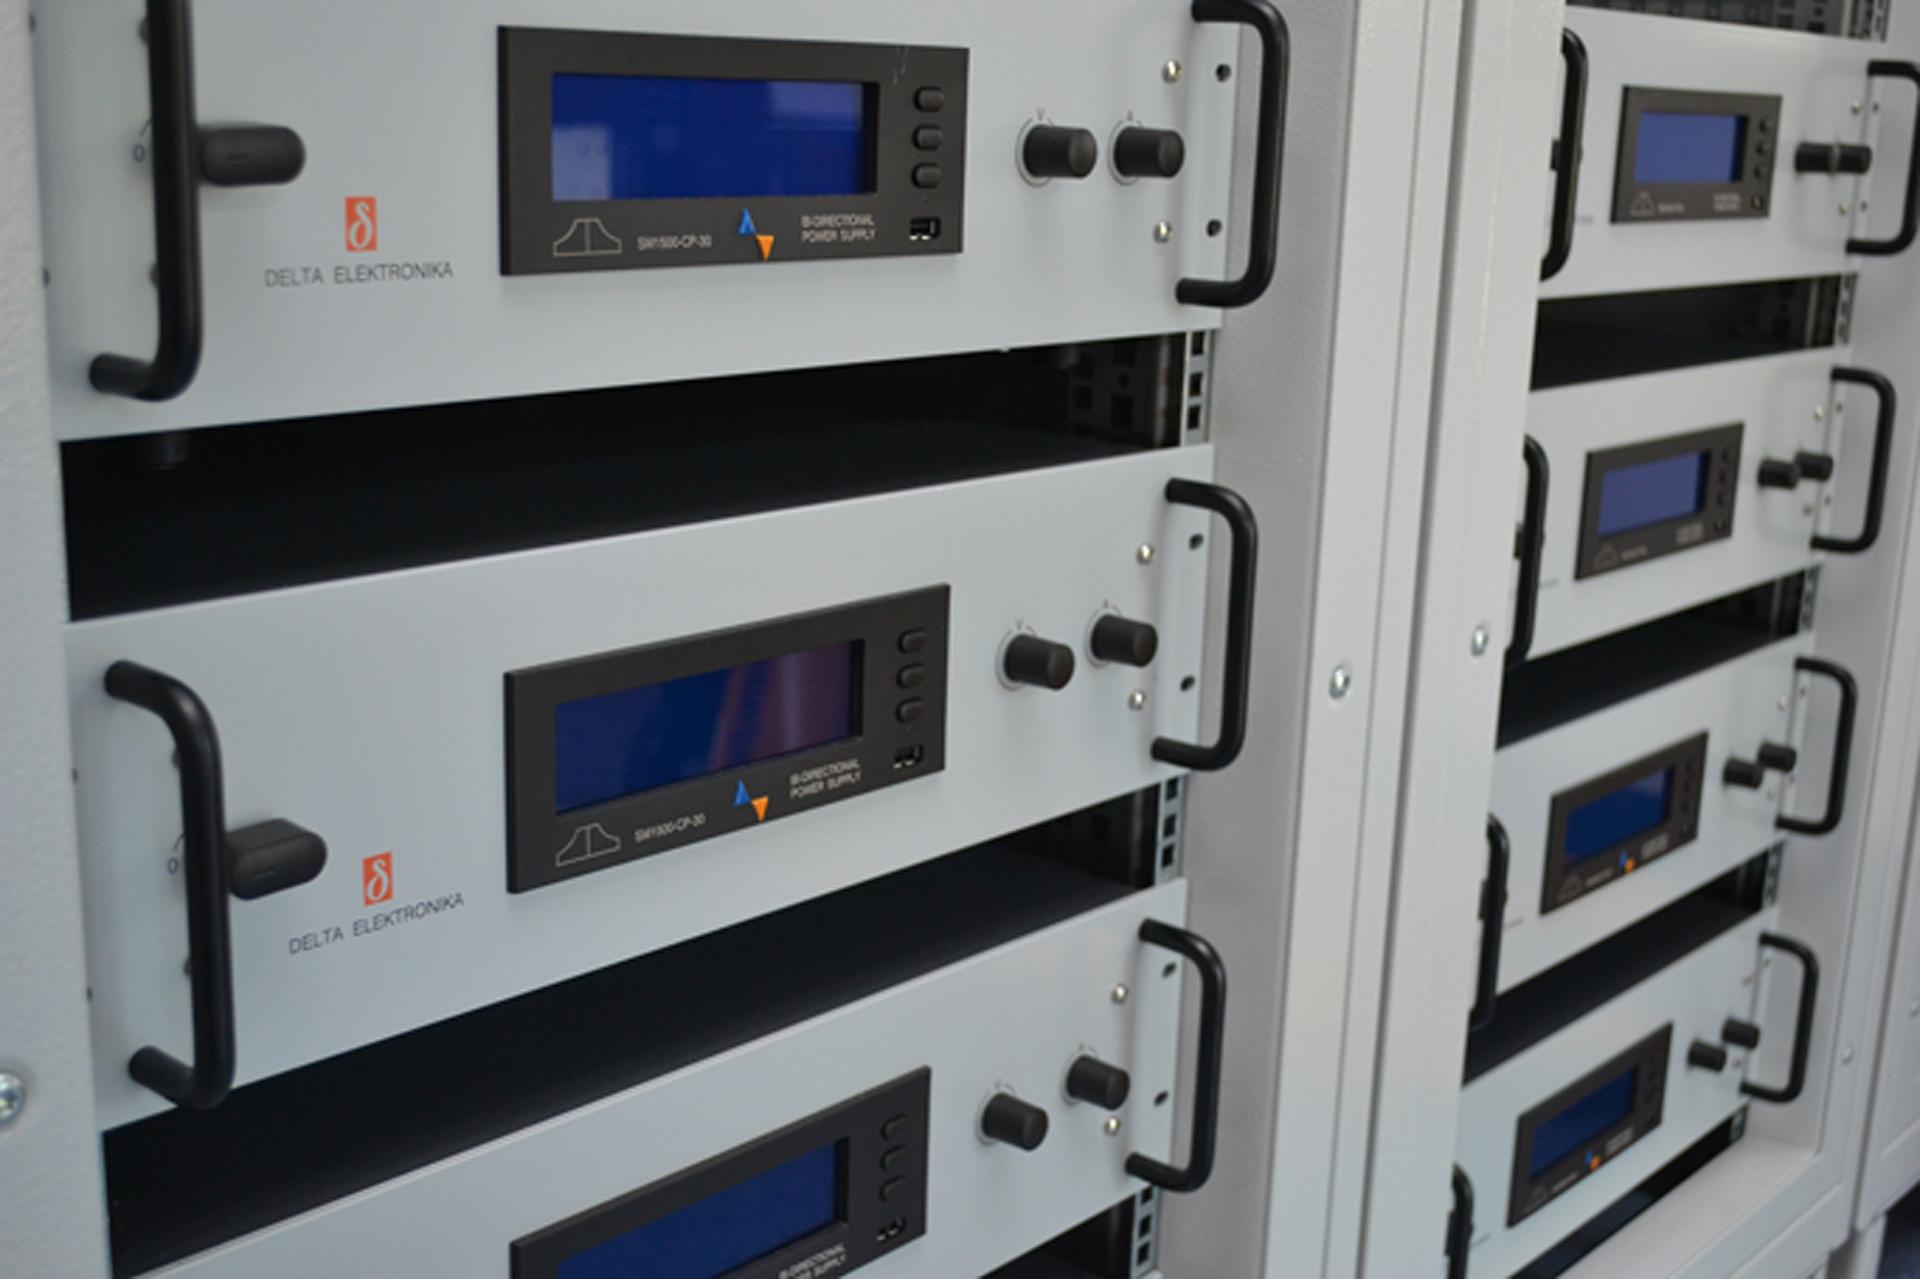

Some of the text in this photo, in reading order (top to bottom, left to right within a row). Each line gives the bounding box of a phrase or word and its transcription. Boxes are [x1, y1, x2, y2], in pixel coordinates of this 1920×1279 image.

[801, 227, 876, 242] POWER SUPPLY
[265, 261, 453, 288] DELTA ELEKTRONIKA
[789, 769, 861, 799] POWER SUPPLY
[288, 893, 464, 954] DELTA ELEKTRONIKA
